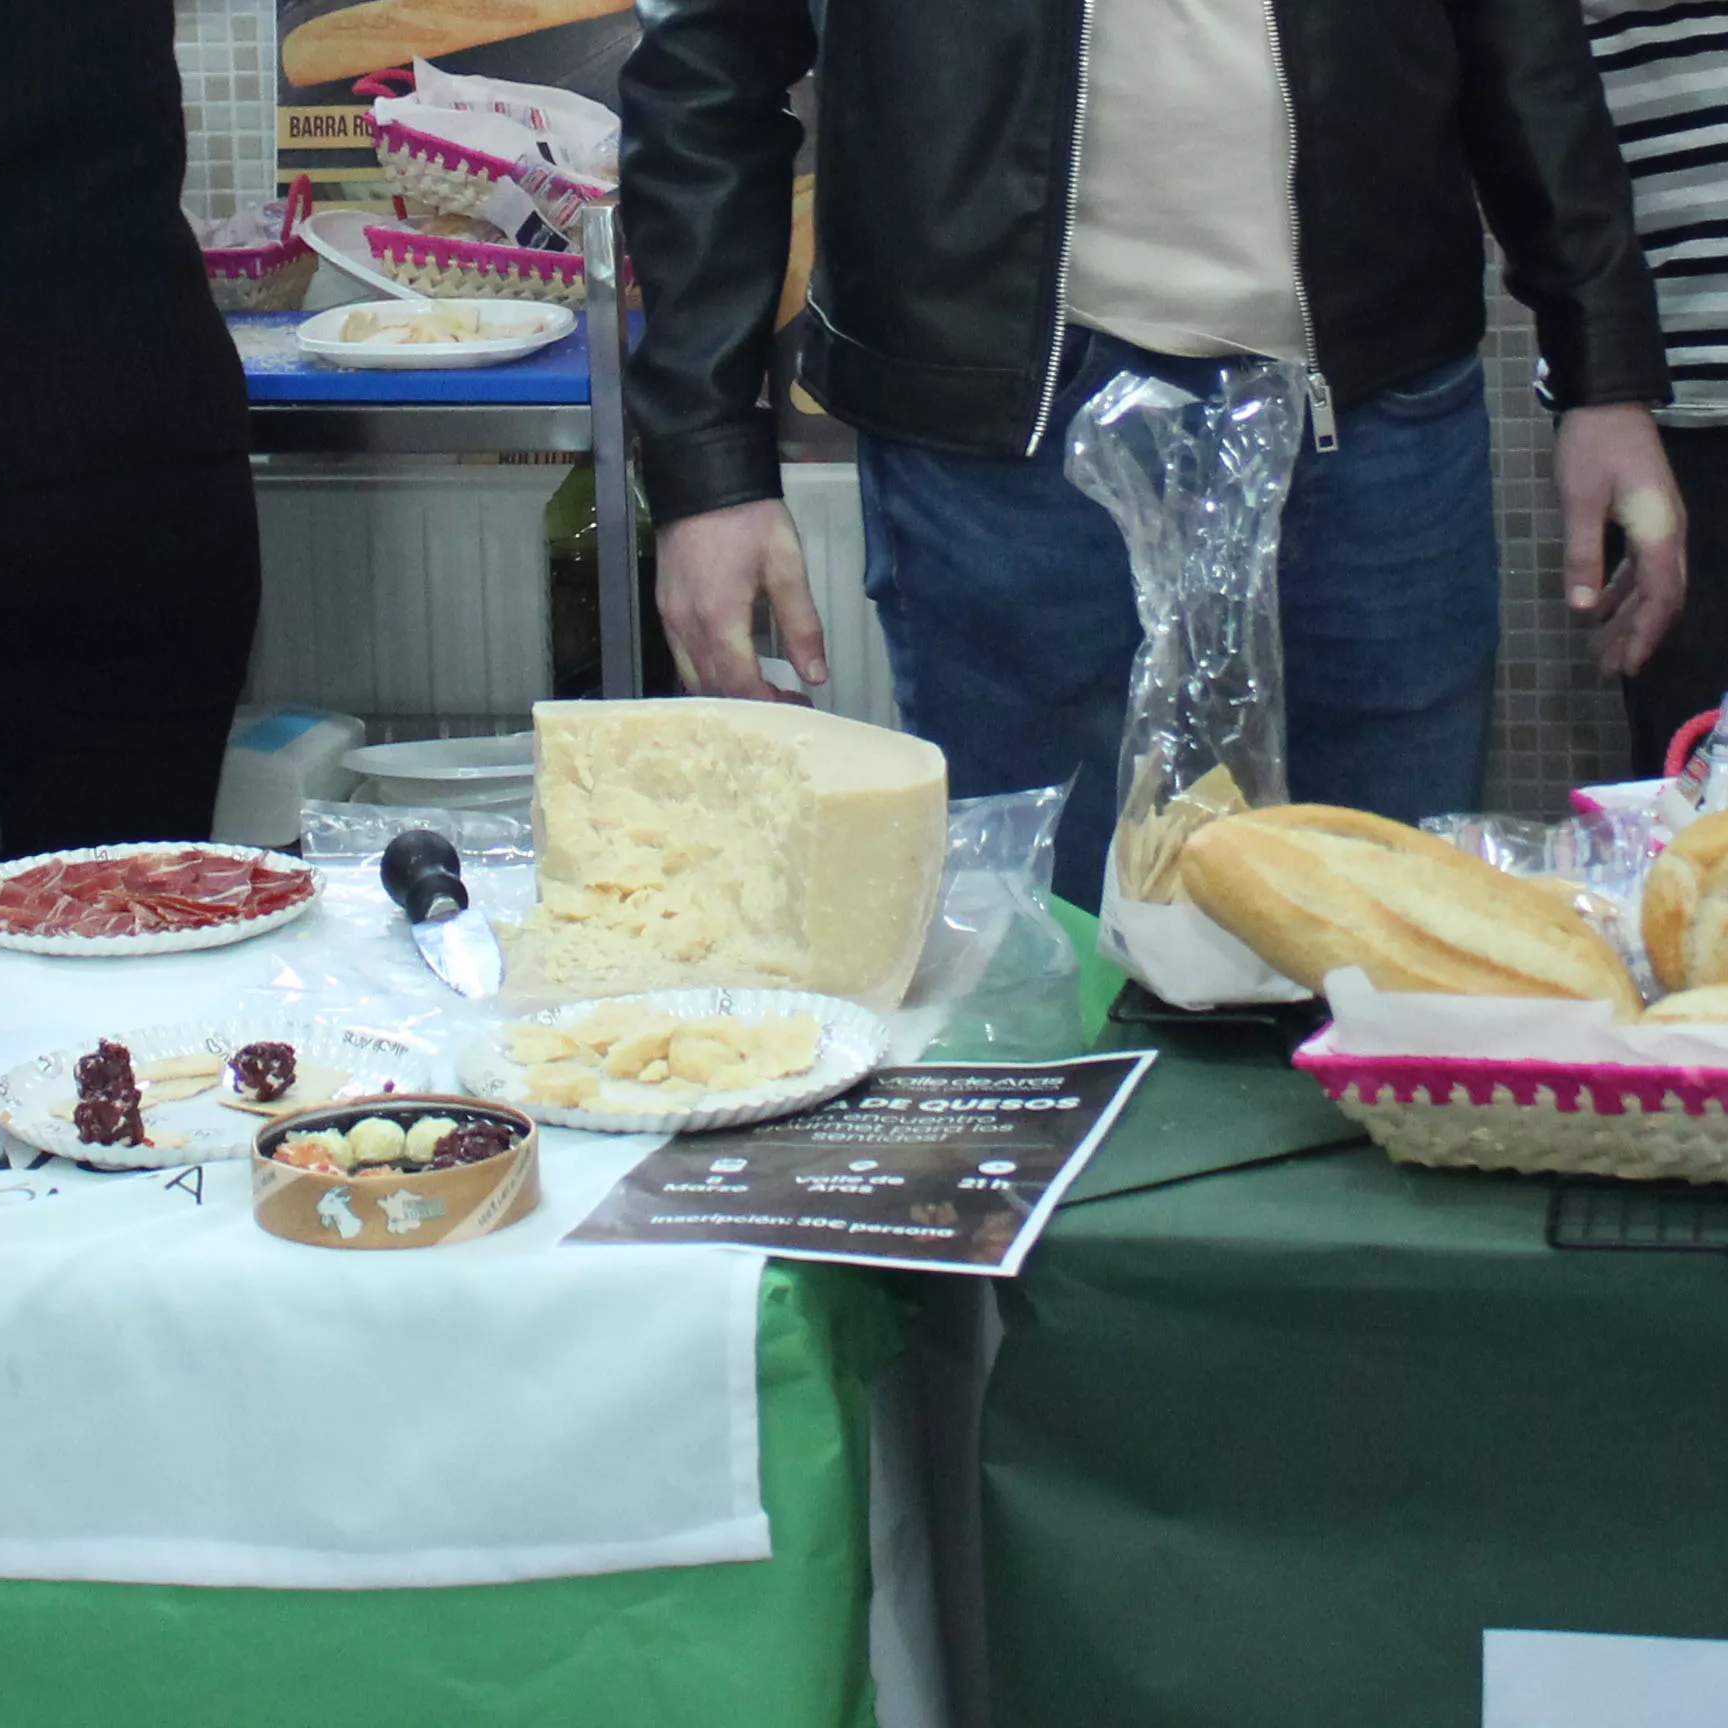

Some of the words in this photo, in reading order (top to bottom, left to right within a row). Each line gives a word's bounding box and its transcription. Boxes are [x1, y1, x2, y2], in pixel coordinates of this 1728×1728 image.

[289, 115, 348, 138] BARRA
[858, 1097, 913, 1110] DE
[918, 1096, 1081, 1112] QUESOS
[843, 1113, 997, 1124] encuentro
[889, 1124, 964, 1136] para
[972, 1123, 1014, 1133] los
[869, 1175, 905, 1185] de
[663, 1183, 749, 1193] Marzo
[849, 1222, 956, 1239] persona
